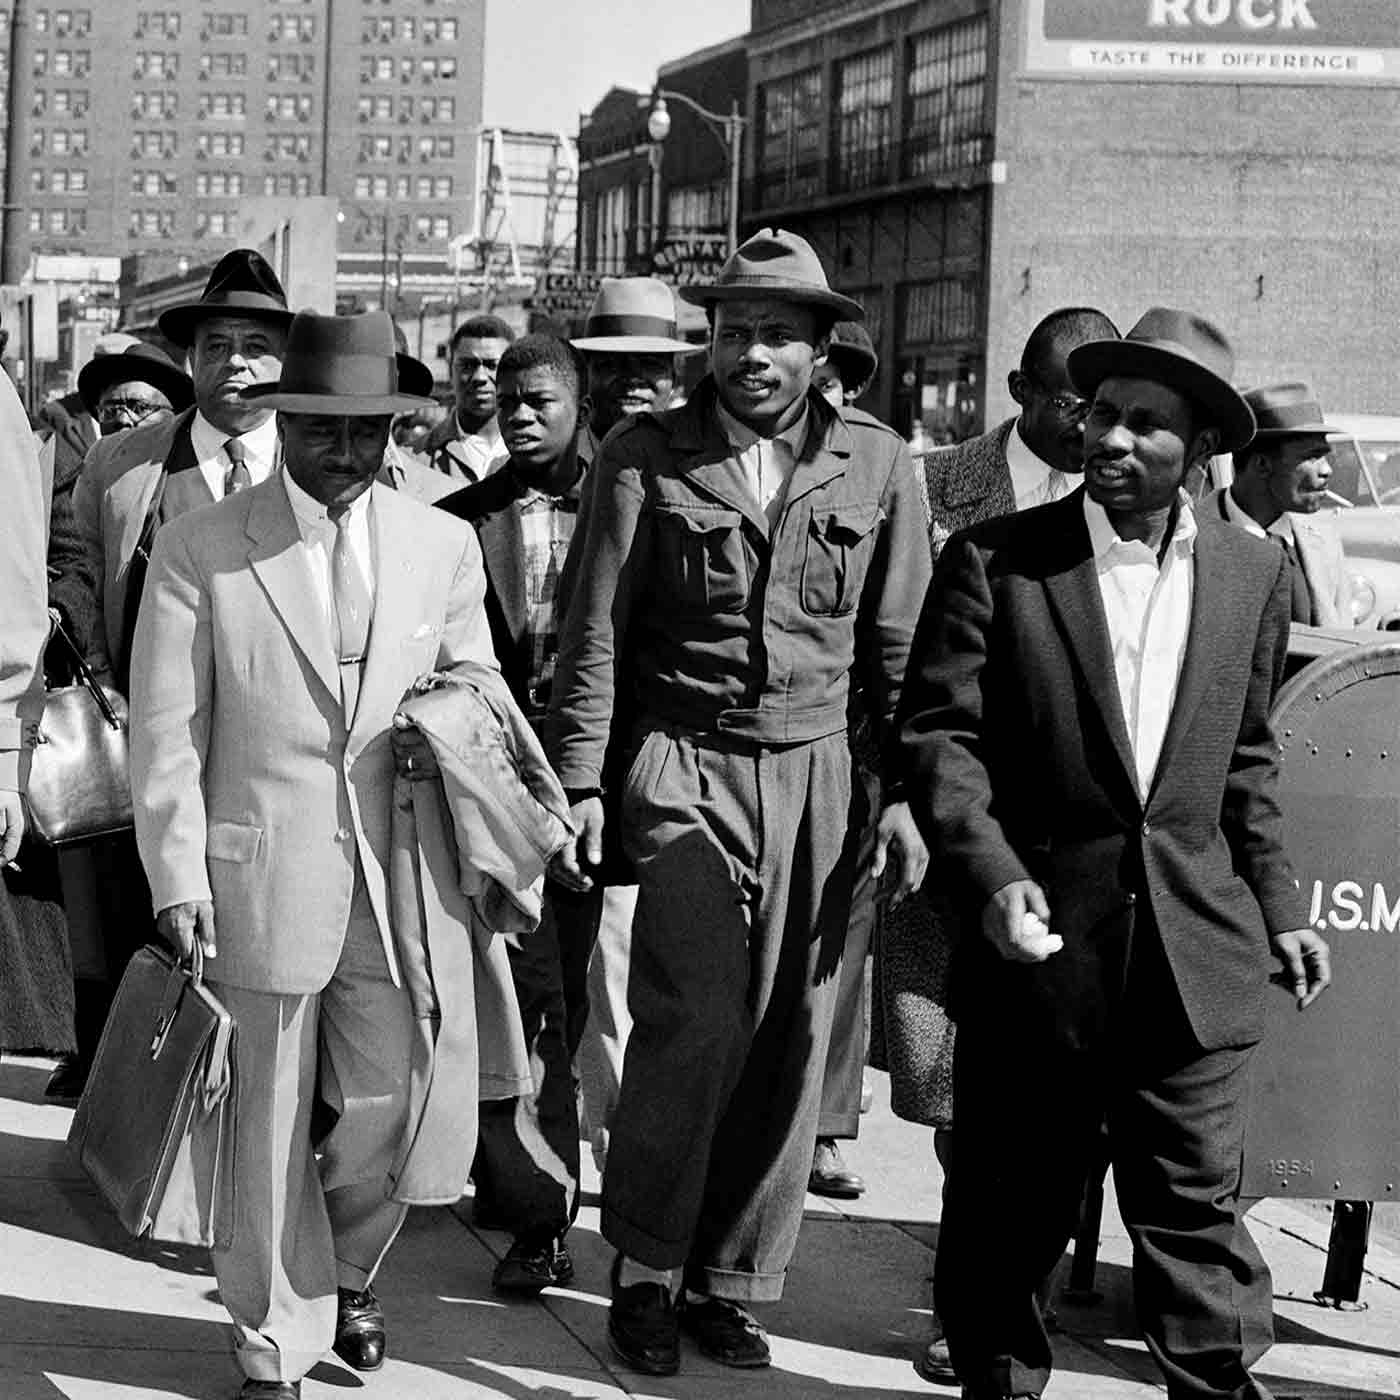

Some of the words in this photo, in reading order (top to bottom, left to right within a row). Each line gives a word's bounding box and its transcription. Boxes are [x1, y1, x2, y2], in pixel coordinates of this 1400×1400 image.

[1089, 50, 1150, 65] TASTE
[1168, 51, 1206, 65] THE
[1221, 52, 1356, 70] DIFFERENCE
[1266, 1159, 1313, 1176] 1954
